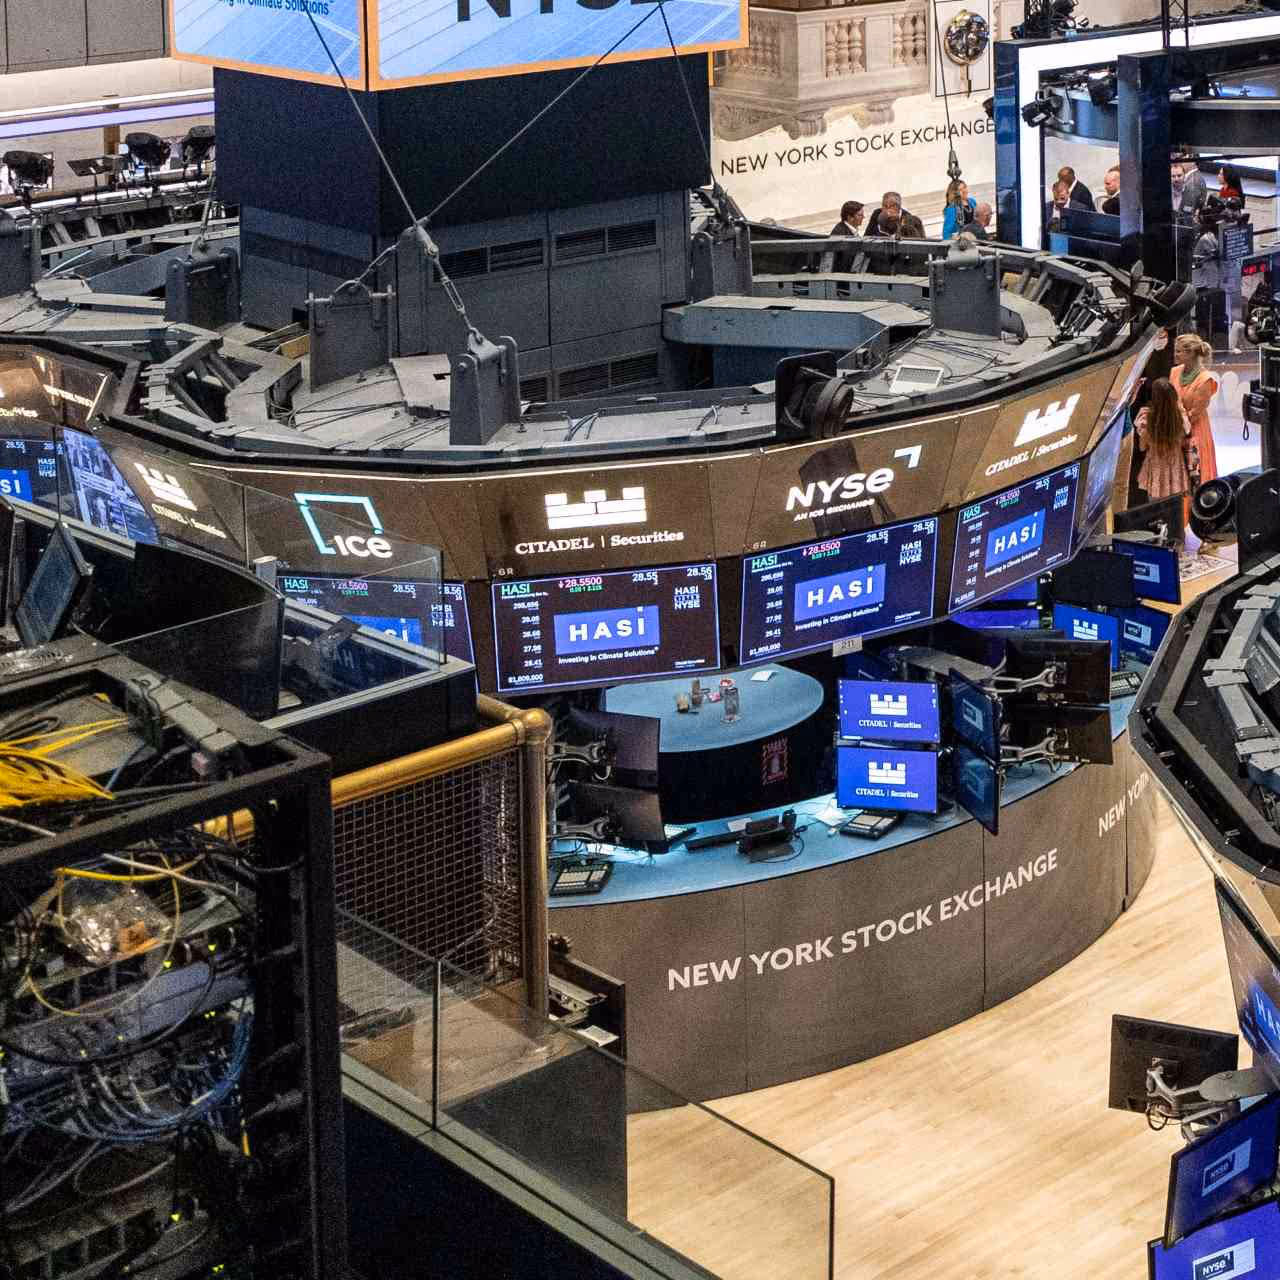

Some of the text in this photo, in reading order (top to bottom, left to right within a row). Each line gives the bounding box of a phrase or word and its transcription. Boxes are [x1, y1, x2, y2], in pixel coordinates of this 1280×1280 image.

[720, 118, 996, 177] NEW YORK STOCK EXCHANGE
[514, 530, 685, 555] CITADEL Securities
[901, 540, 921, 551] HASI
[993, 522, 1038, 555] HASI
[751, 555, 777, 569] HASI
[284, 578, 309, 590] HASI
[501, 566, 712, 596] HASI 28.5500 28.55 28.56
[674, 585, 699, 595] HASI
[807, 576, 873, 608] HASI
[568, 617, 645, 642] HASI
[558, 651, 624, 665] Investing Climate
[858, 719, 888, 728] CITADEL
[856, 787, 885, 797] CITADEL
[1098, 794, 1126, 838] NEW
[667, 847, 1059, 991] NEW YORK STOCK EXCHANGE
